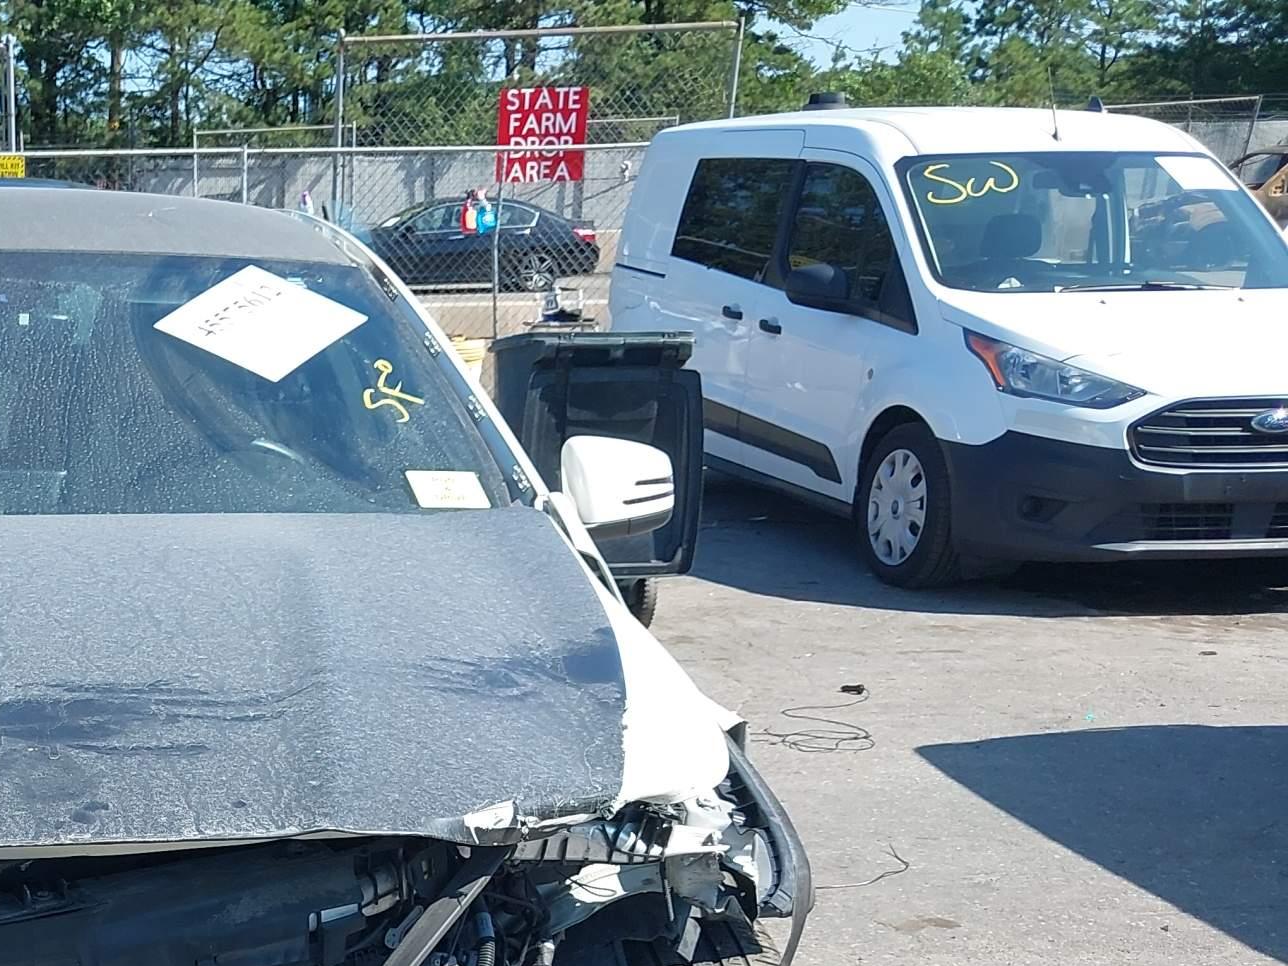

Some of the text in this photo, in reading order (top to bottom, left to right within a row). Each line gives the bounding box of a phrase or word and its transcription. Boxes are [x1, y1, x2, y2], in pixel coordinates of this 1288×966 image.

[506, 86, 582, 111] STATE
[508, 111, 577, 136] FARM
[509, 136, 574, 159] DROP
[506, 160, 571, 183] AREA
